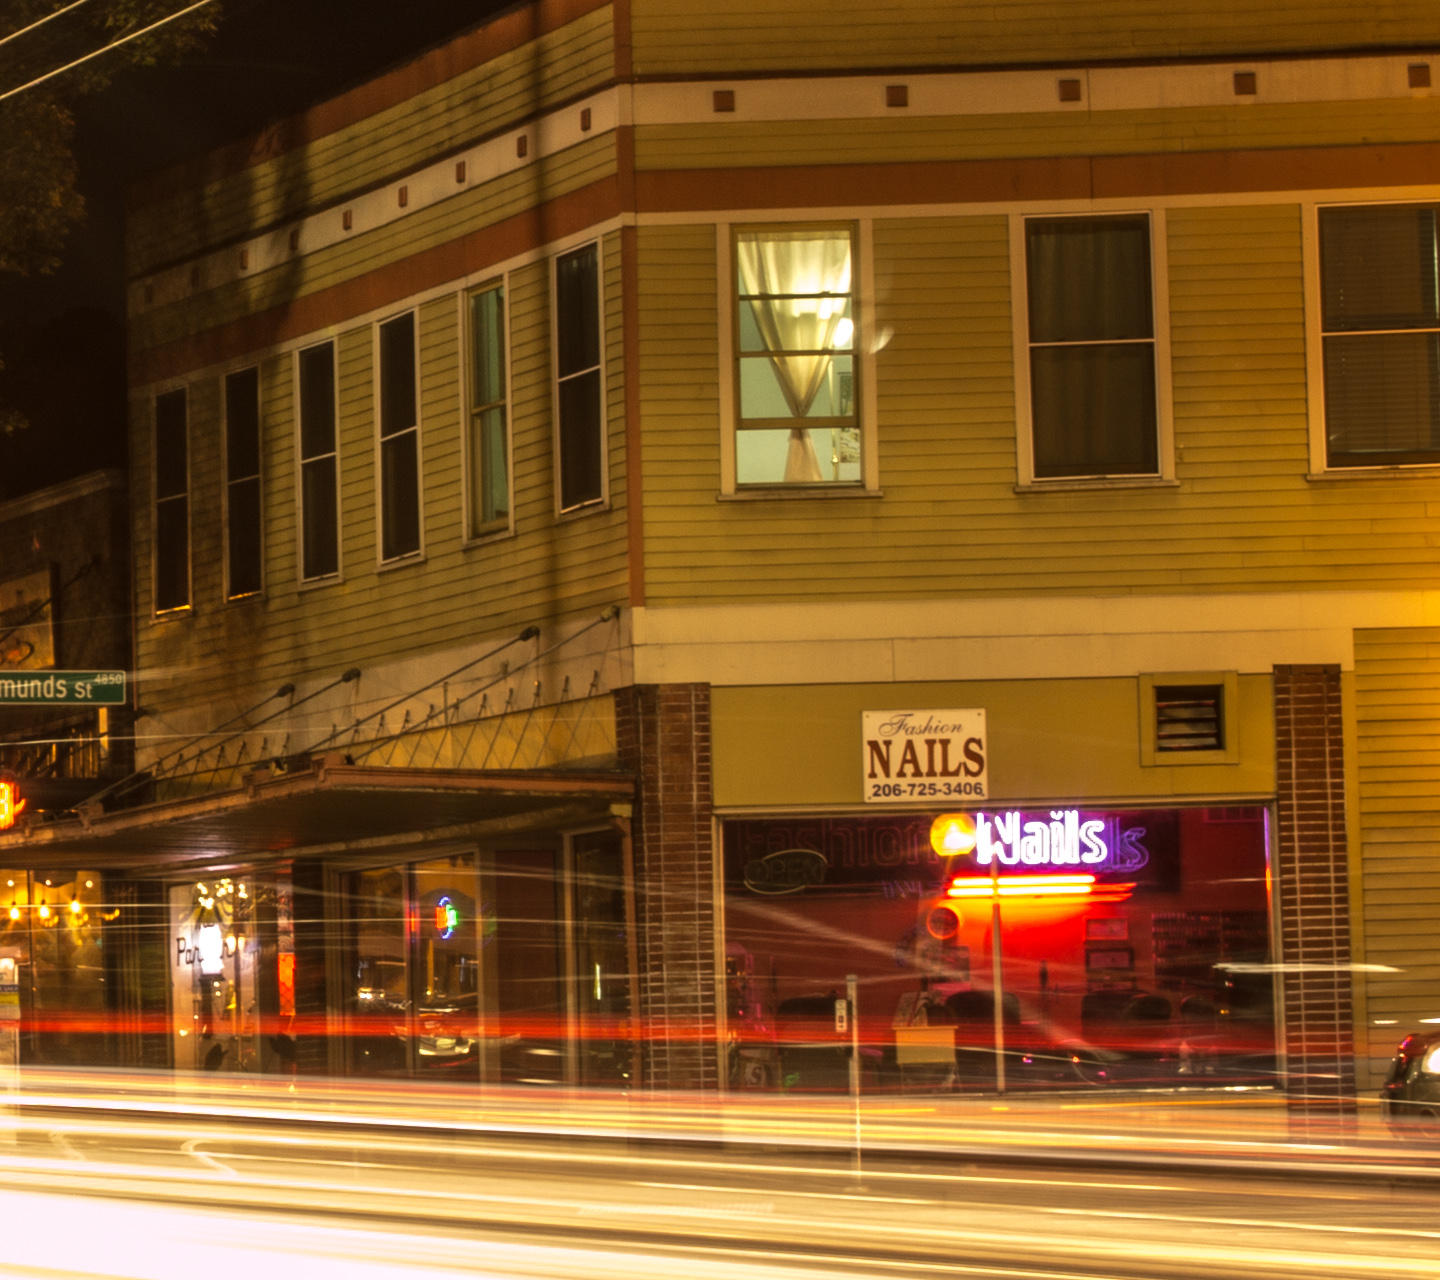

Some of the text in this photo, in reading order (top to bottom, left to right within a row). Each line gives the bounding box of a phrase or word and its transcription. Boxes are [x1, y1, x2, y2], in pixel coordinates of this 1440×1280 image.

[94, 673, 122, 685] 4850
[74, 680, 93, 699] St
[878, 713, 963, 737] Fashion
[866, 737, 985, 779] NAILS
[872, 782, 984, 797] 206-725-3406
